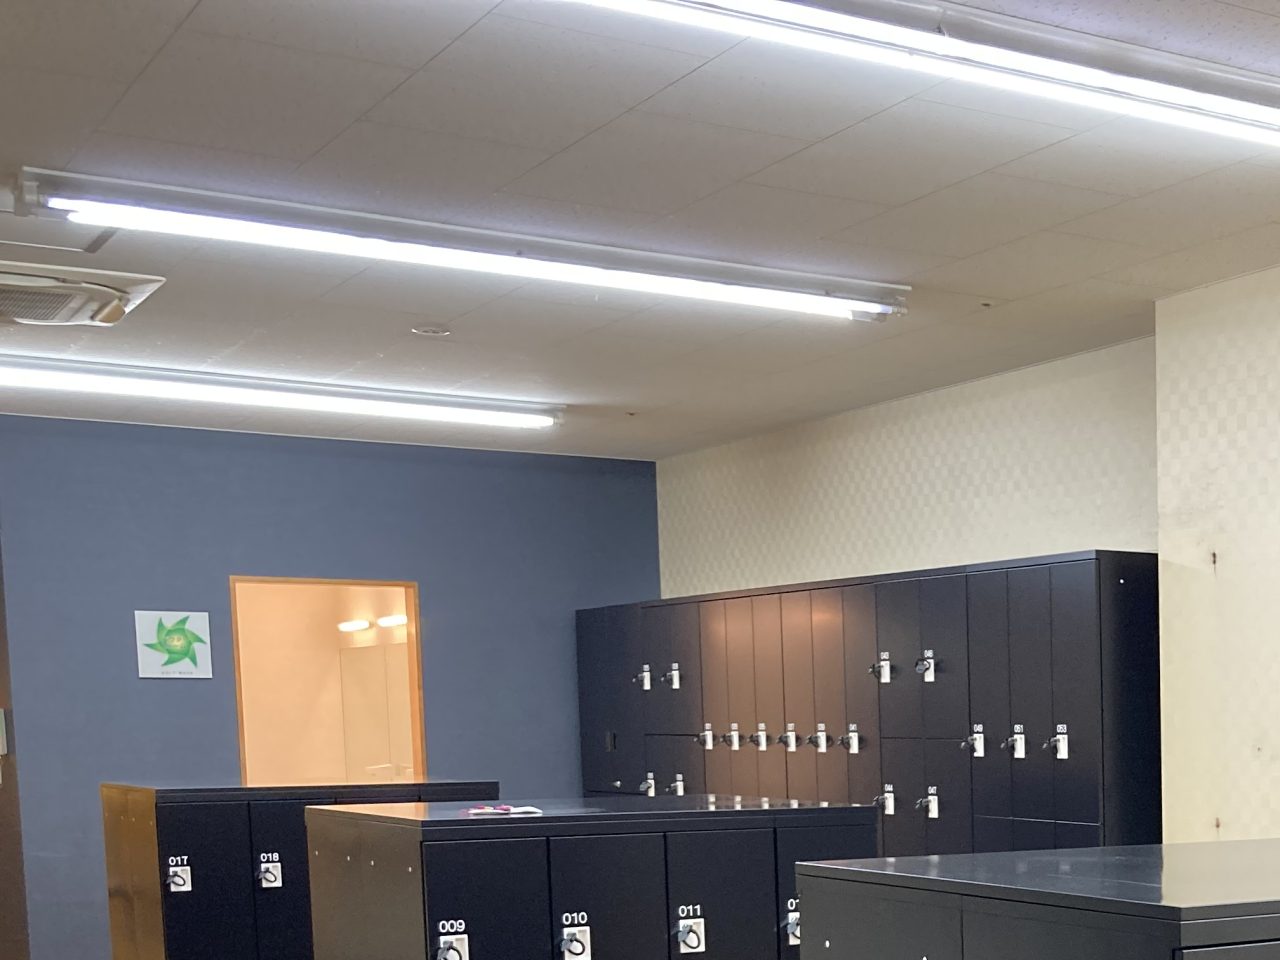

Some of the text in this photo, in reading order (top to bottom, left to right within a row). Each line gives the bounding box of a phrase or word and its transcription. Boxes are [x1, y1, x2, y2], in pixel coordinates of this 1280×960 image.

[168, 855, 189, 866] 017
[261, 853, 279, 861] 018
[679, 905, 700, 917] 011
[563, 912, 587, 924] 010
[439, 920, 466, 934] 009
